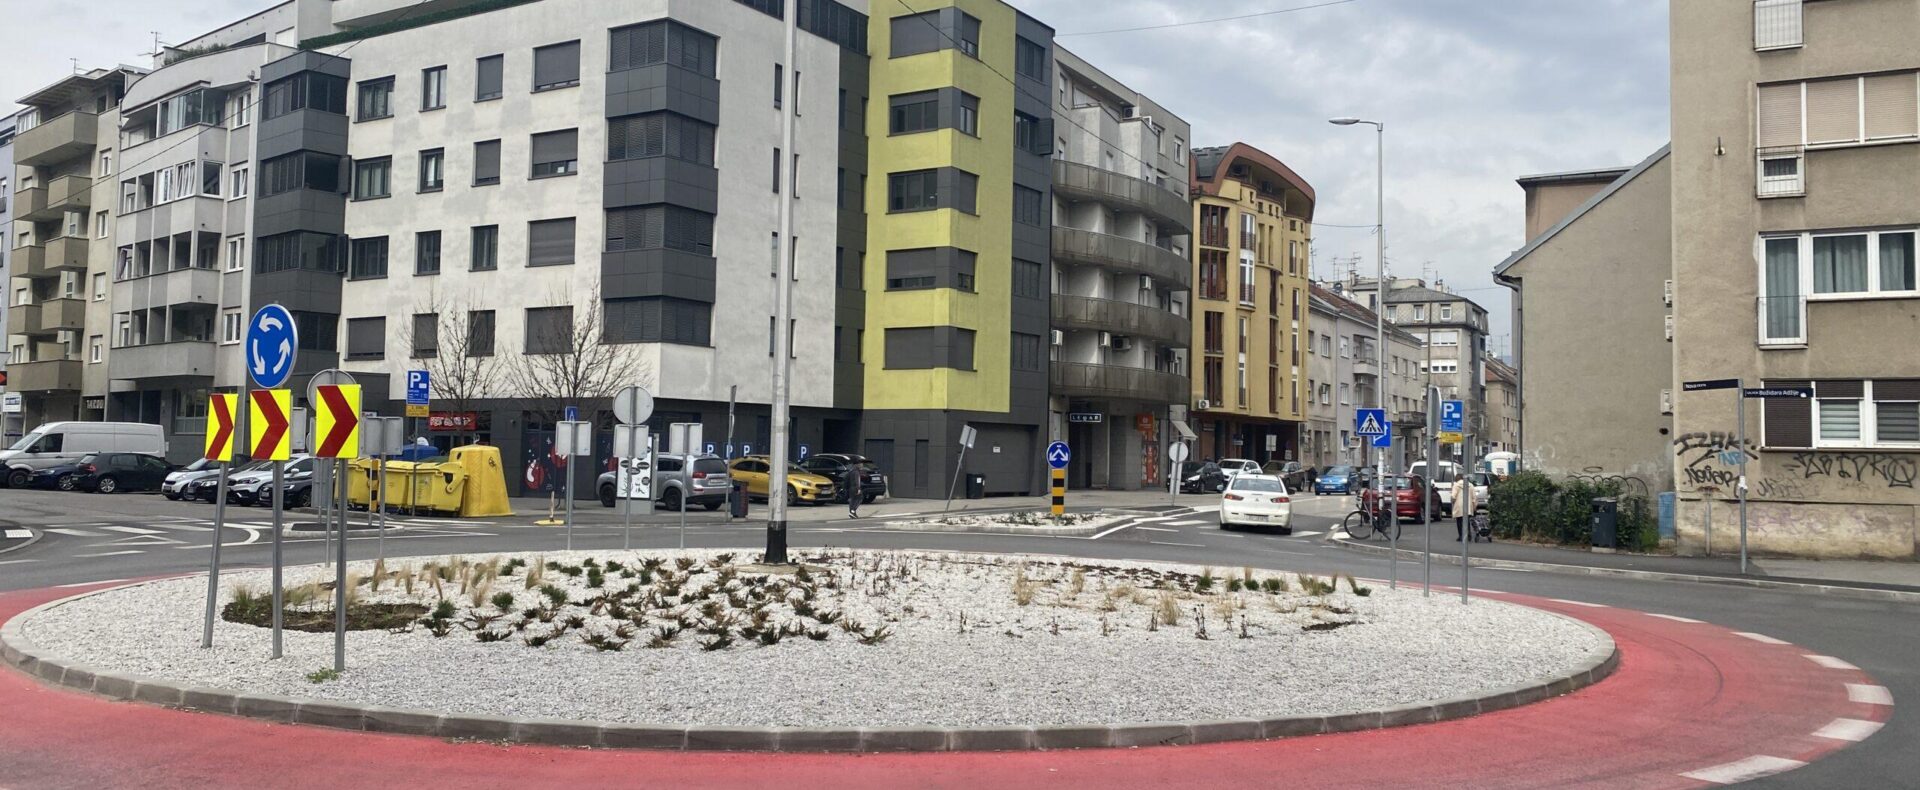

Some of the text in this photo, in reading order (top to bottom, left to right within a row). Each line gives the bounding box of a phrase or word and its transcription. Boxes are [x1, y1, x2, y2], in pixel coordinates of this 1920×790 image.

[410, 372, 421, 389] P
[1443, 402, 1455, 418] P
[707, 444, 714, 456] P
[743, 444, 750, 456] P
[800, 446, 807, 459] P
